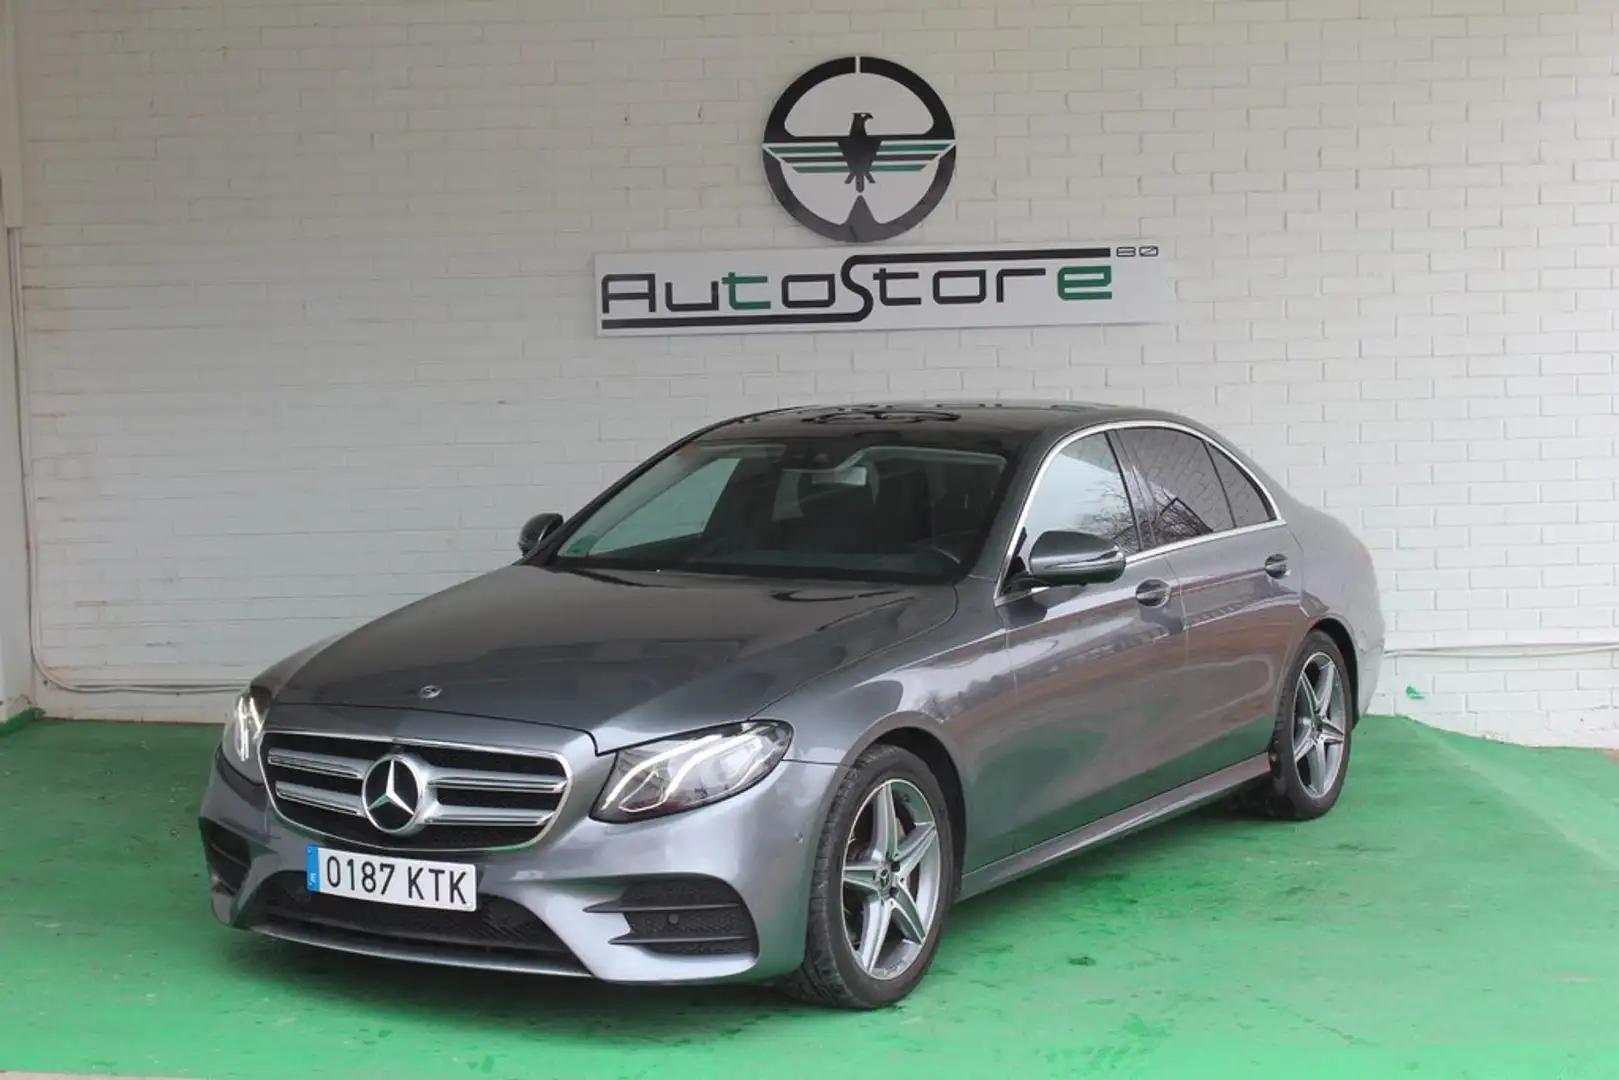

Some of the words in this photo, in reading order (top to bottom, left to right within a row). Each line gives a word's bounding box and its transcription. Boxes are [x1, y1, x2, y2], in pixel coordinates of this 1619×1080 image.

[601, 249, 1113, 329] AutoStore
[1116, 245, 1159, 258] 80
[326, 855, 396, 896] 0187
[407, 865, 467, 905] KTK
